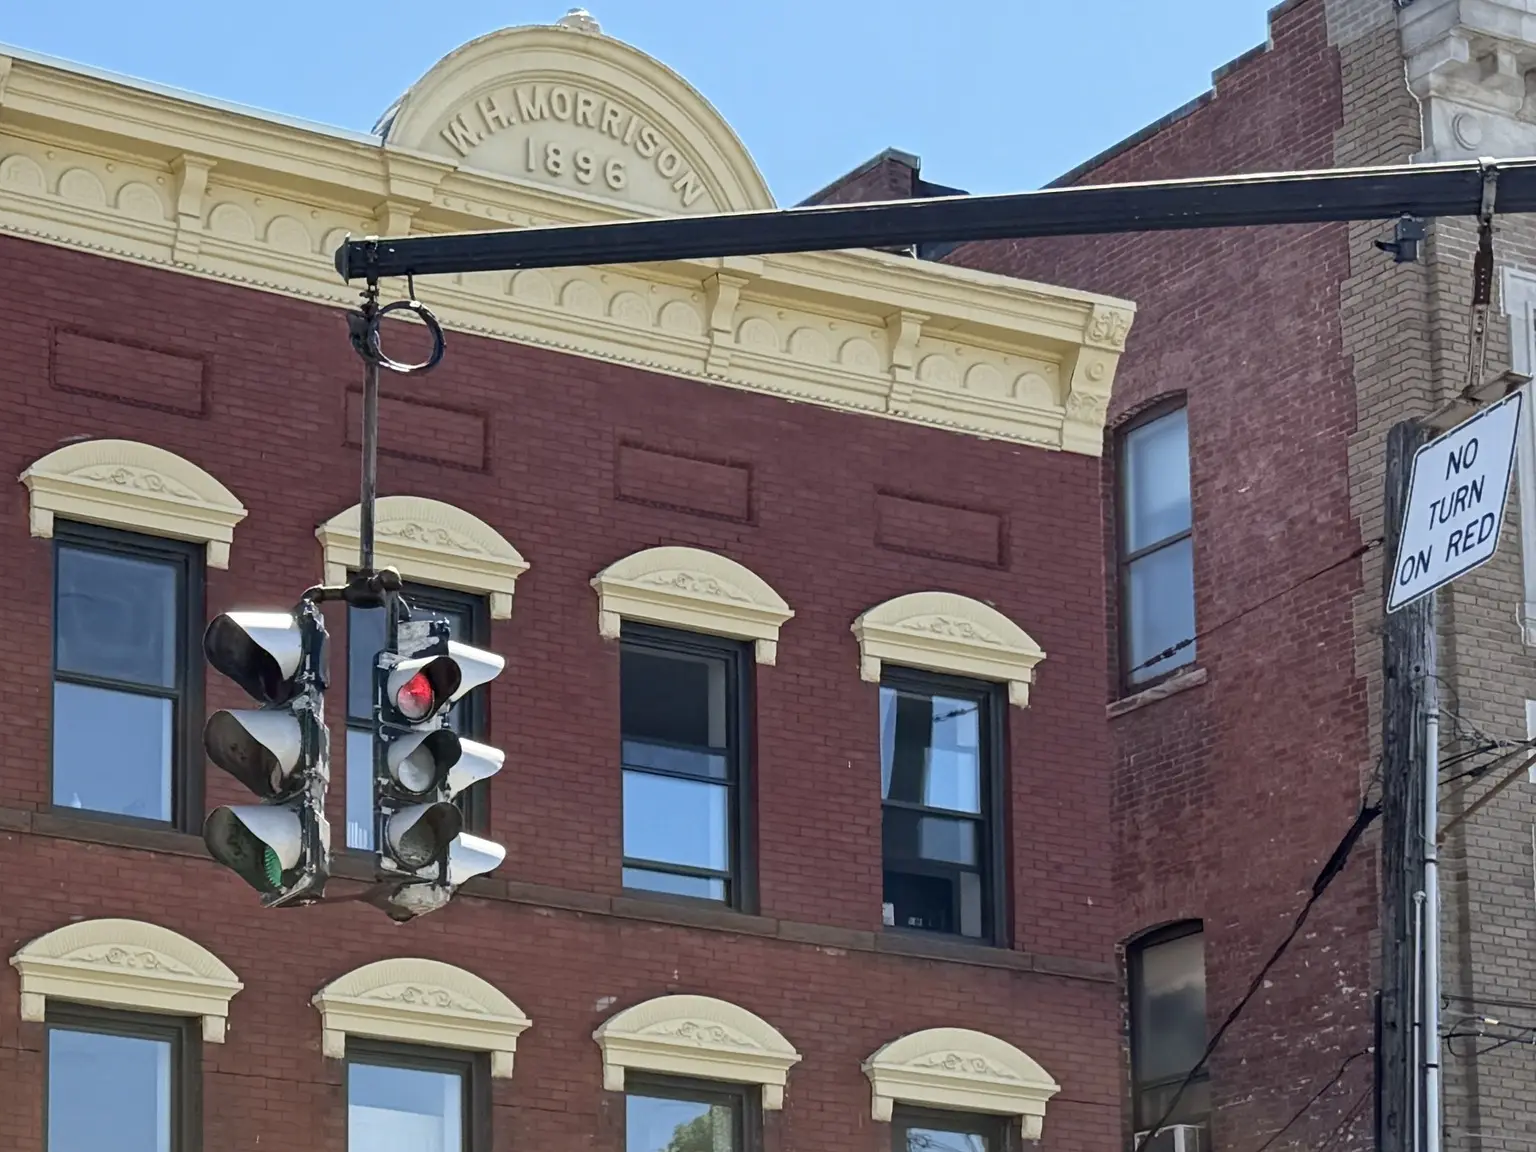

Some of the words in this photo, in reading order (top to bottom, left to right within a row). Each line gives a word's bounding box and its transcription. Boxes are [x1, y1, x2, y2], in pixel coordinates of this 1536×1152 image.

[525, 136, 628, 190] 1896
[1445, 437, 1479, 481] NO
[1429, 474, 1485, 531] TURN
[1399, 545, 1433, 586] ON
[1444, 511, 1495, 563] RED
